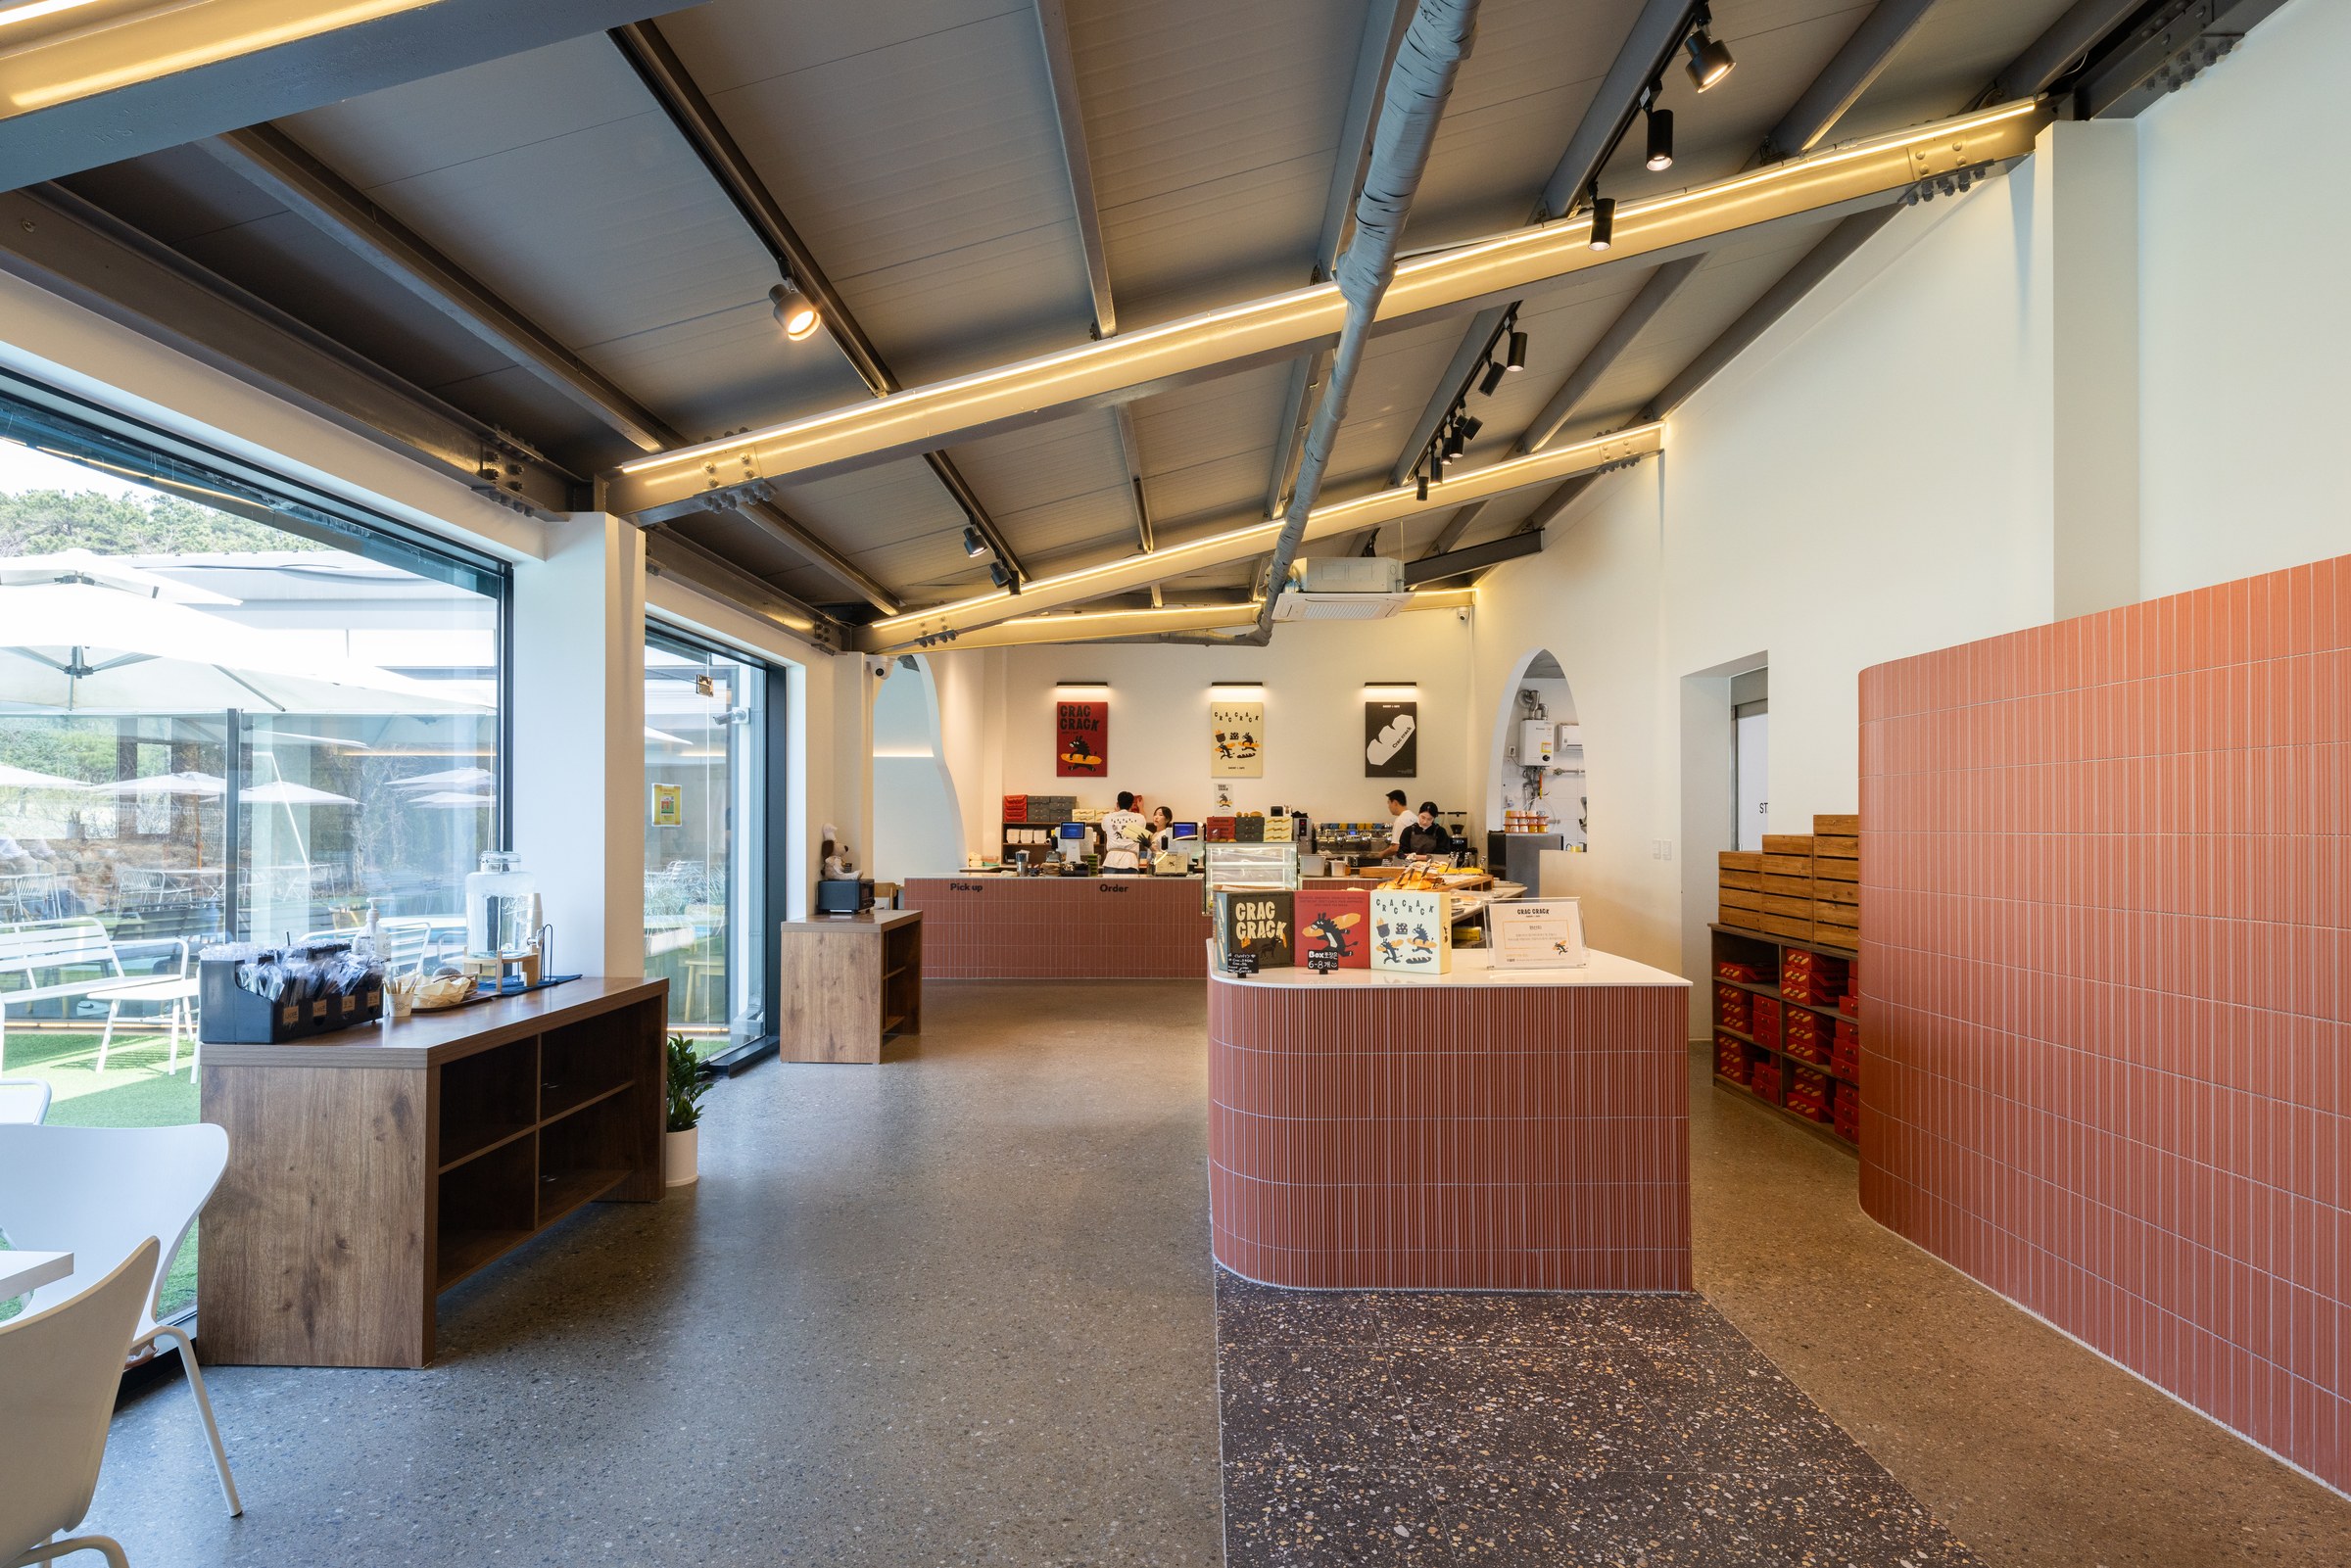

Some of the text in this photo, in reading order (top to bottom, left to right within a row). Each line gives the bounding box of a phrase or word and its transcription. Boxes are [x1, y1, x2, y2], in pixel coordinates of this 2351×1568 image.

[1060, 705, 1090, 717] CRAC
[1060, 718, 1099, 732] CRACK
[950, 882, 970, 891] Pick
[1099, 883, 1128, 892] Order
[1235, 901, 1275, 921] CRAC
[1376, 898, 1398, 915] CRAC
[1402, 899, 1434, 915] CRACK
[1236, 921, 1287, 940] CRACK
[1309, 950, 1323, 959] Box
